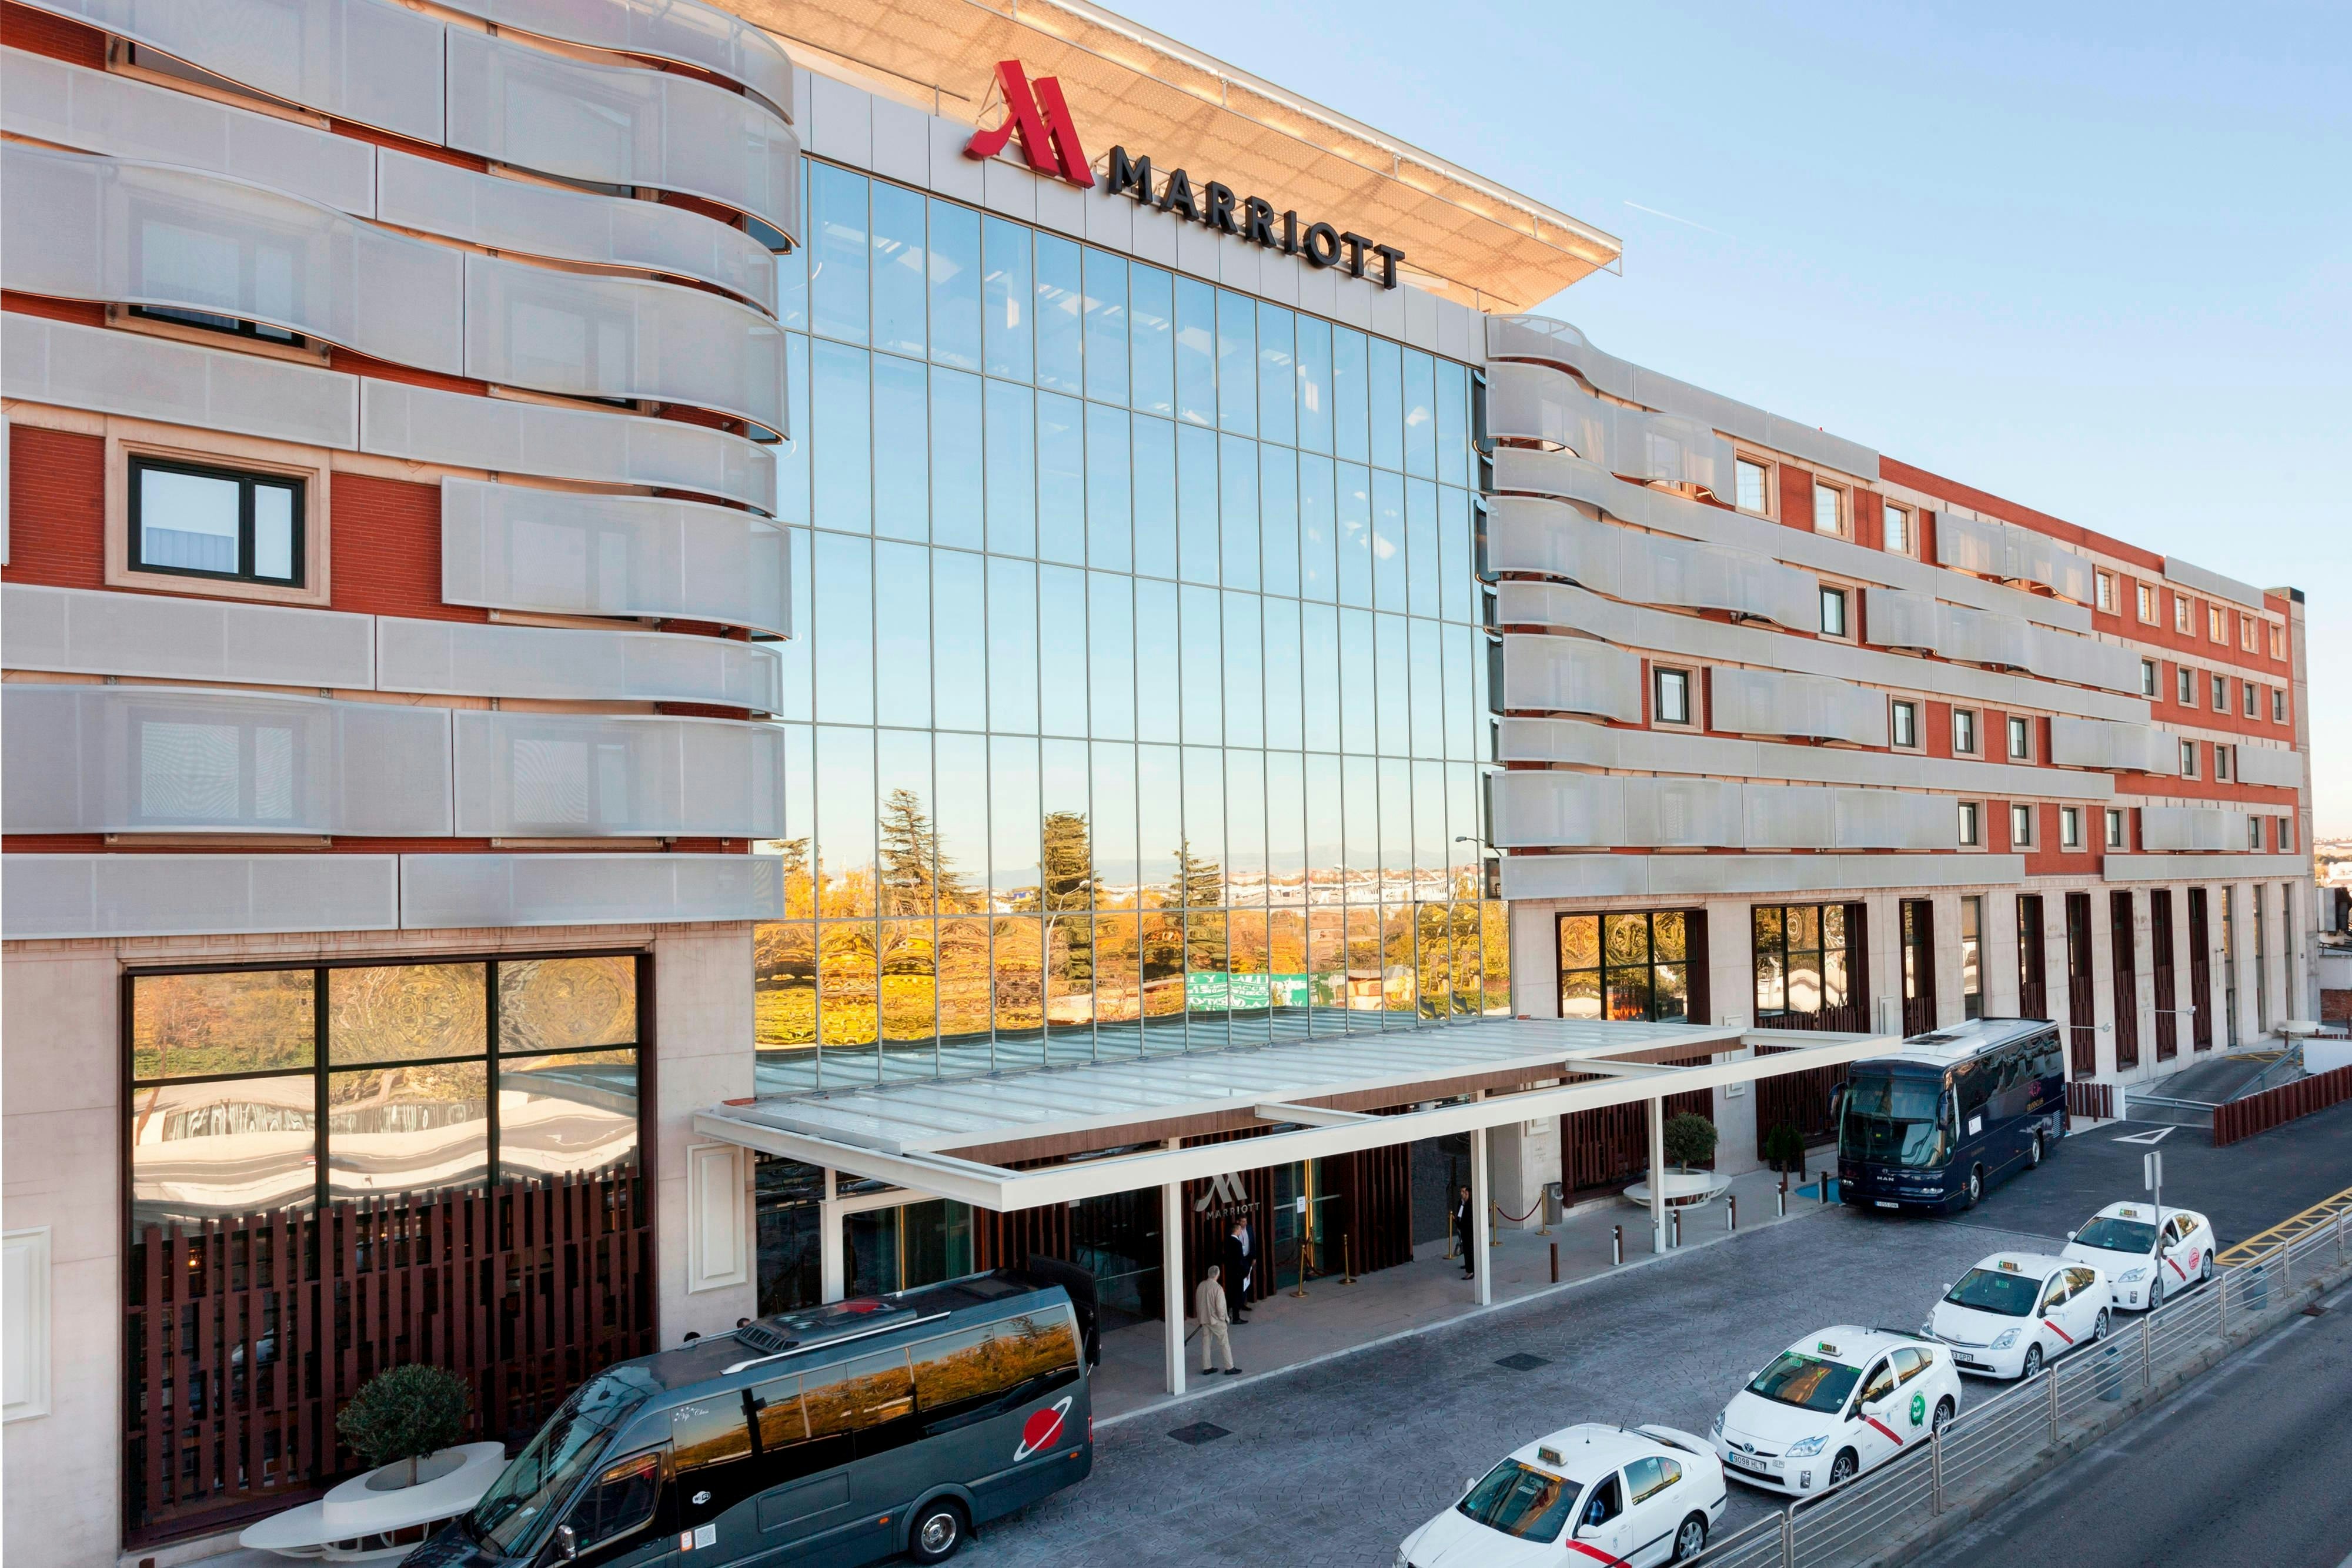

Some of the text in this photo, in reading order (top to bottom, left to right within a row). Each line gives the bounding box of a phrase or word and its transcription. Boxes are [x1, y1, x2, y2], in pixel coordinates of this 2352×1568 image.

[1108, 145, 1405, 290] MARRIOTT
[1206, 1202, 1260, 1221] MARRIOTT
[1733, 1455, 1749, 1466] 9098
[1751, 1460, 1763, 1470] HLT
